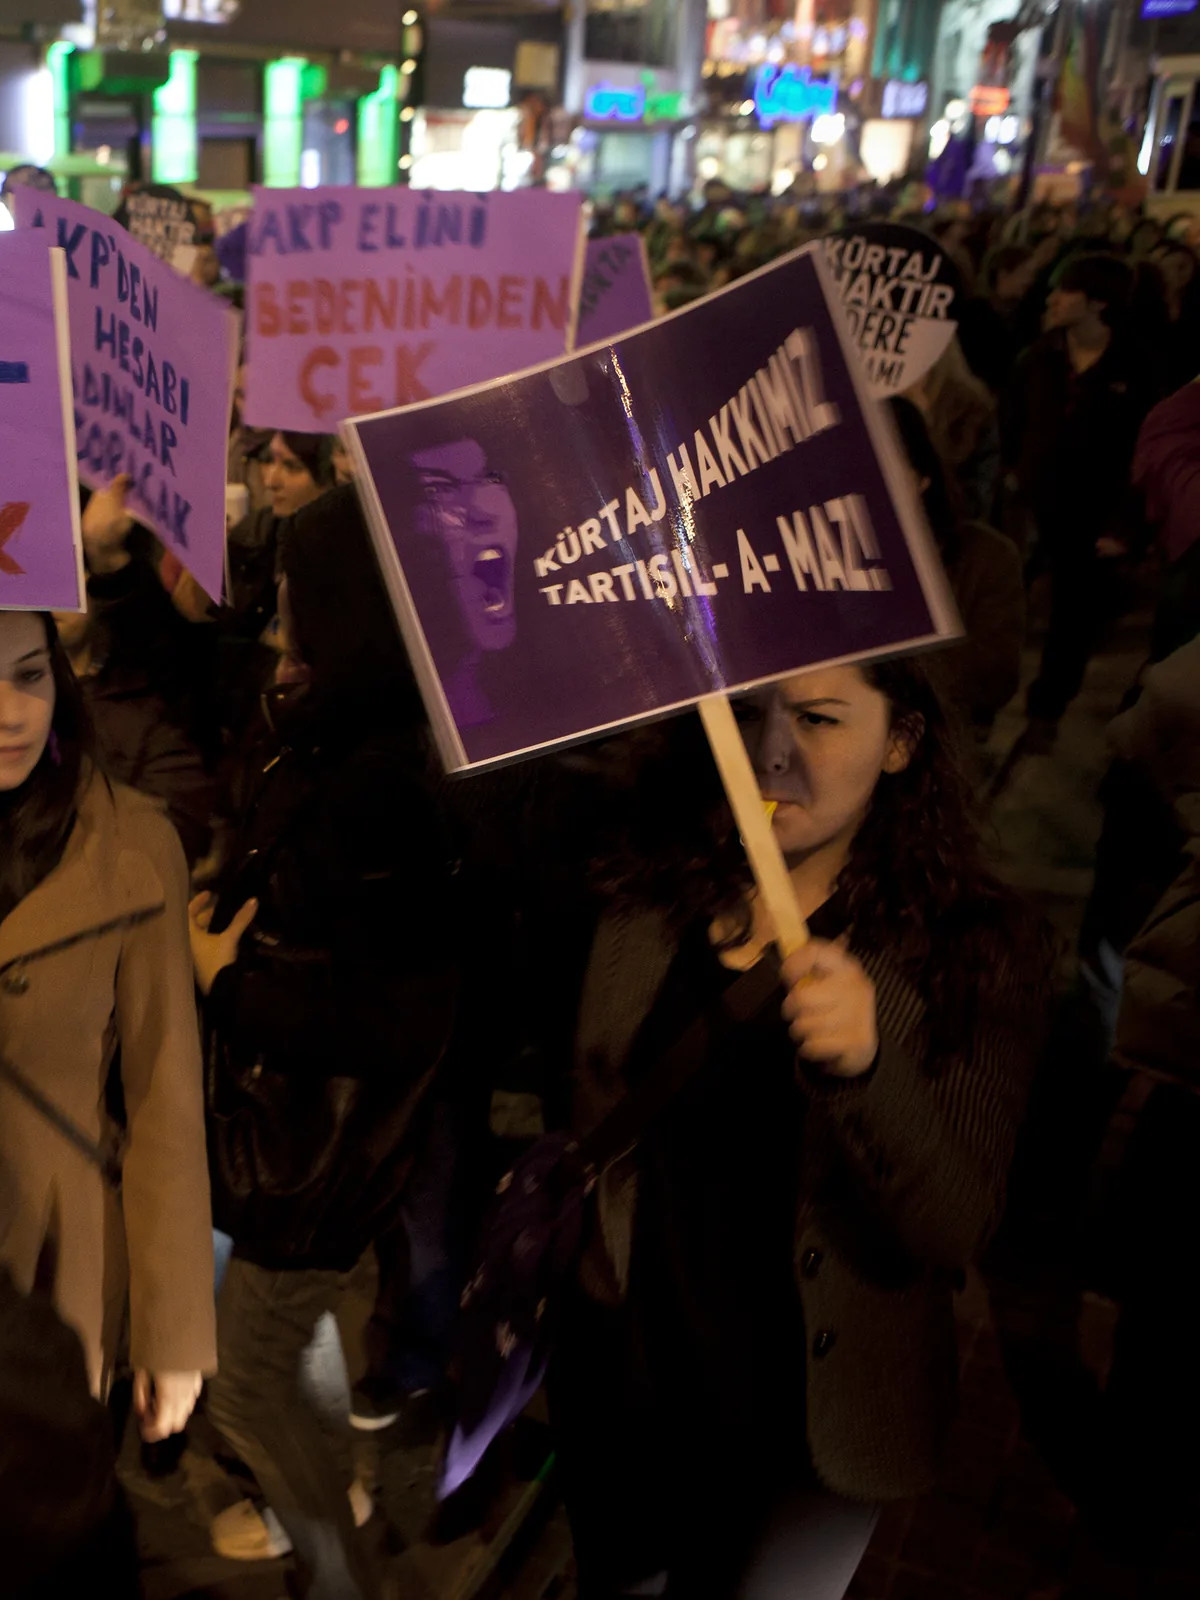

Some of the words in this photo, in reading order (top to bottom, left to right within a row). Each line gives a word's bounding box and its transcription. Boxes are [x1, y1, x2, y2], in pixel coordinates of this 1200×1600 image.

[252, 201, 346, 256] AKP
[255, 265, 570, 338] BEDENİMDEN
[94, 304, 190, 427] HESABI
[302, 340, 438, 418] ÇEK
[533, 467, 667, 579] KÜRTAJ
[665, 326, 842, 502] HAKKIMIZ
